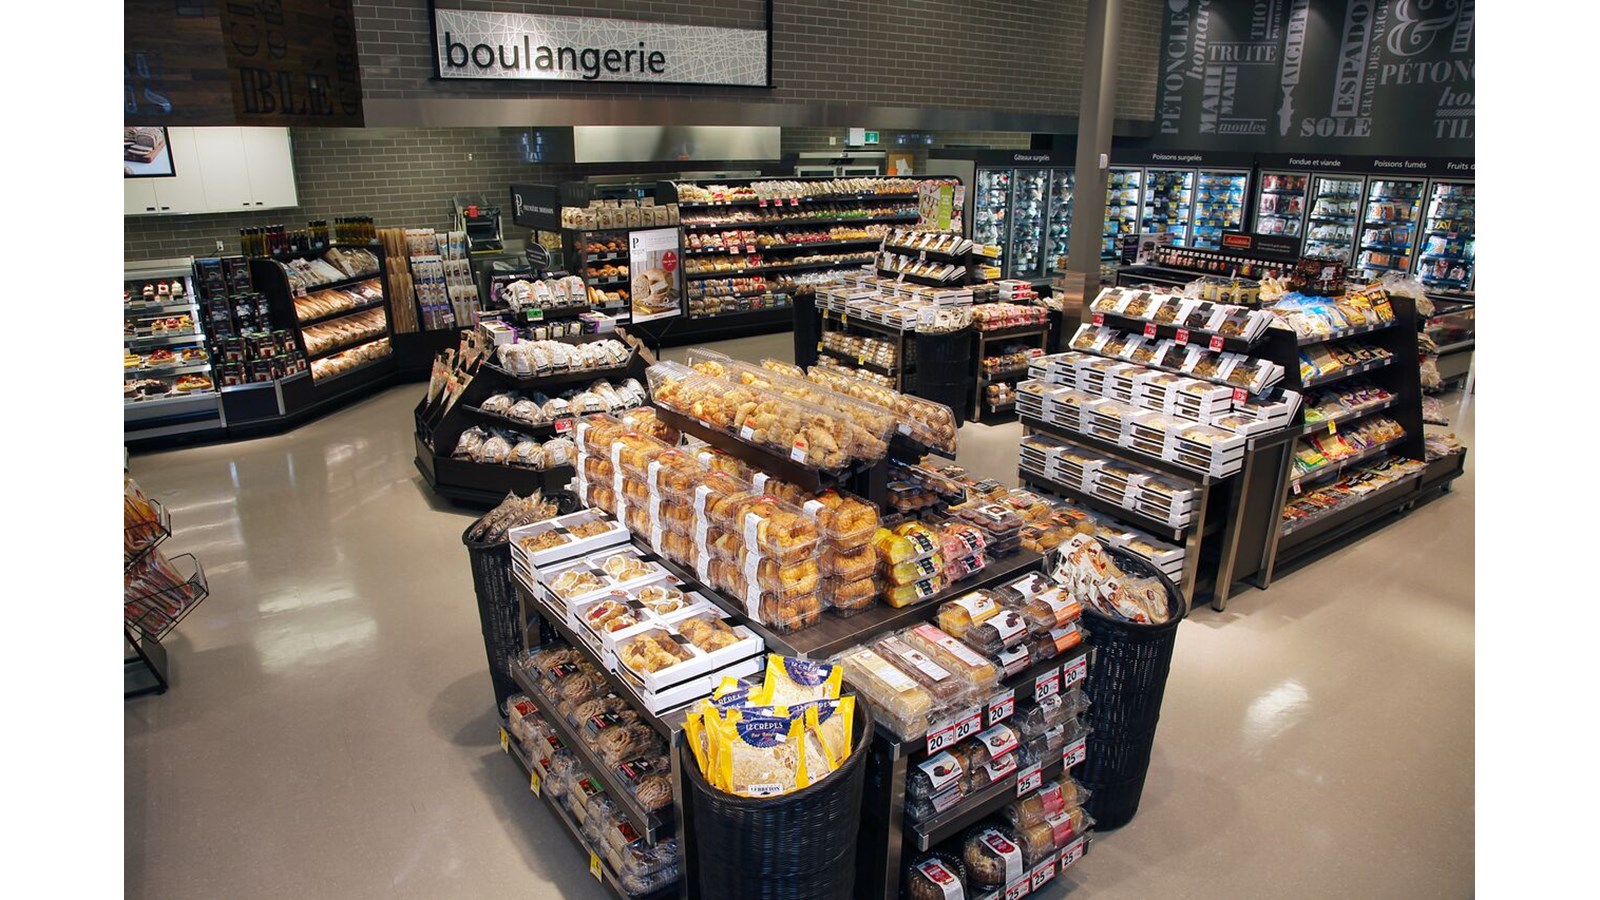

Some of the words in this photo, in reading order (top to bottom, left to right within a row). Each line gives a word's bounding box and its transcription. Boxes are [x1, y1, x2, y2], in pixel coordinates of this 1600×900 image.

[1251, 0, 1267, 39] THO
[1284, 0, 1307, 78] AIGLEFI
[445, 31, 666, 80] boulangerie
[1207, 44, 1277, 62] TRUITE
[1337, 0, 1370, 111] ESPADO
[1159, 12, 1191, 134] PÉTONCLE
[1380, 59, 1475, 85] PÉTON
[240, 60, 334, 116] BLÉ
[1220, 66, 1238, 114] MAHI
[1199, 66, 1223, 133] MAHI
[1438, 86, 1475, 106] ho
[1300, 117, 1372, 137] SOLE
[1177, 154, 1202, 163] surgelés
[1289, 157, 1312, 165] Fondue
[1320, 159, 1341, 167] viande
[1374, 159, 1403, 168] Poissons
[1404, 160, 1427, 169] fumés
[1447, 161, 1468, 170] Fruits
[1066, 670, 1077, 684] 20
[1037, 684, 1049, 698] 20
[991, 706, 1003, 721] 20
[957, 723, 970, 738] 20
[930, 735, 943, 751] 20
[1066, 754, 1076, 767] 25
[1019, 780, 1031, 792] 25
[1063, 853, 1074, 866] 25
[1034, 872, 1045, 885] 25
[1008, 887, 1019, 900] 25
